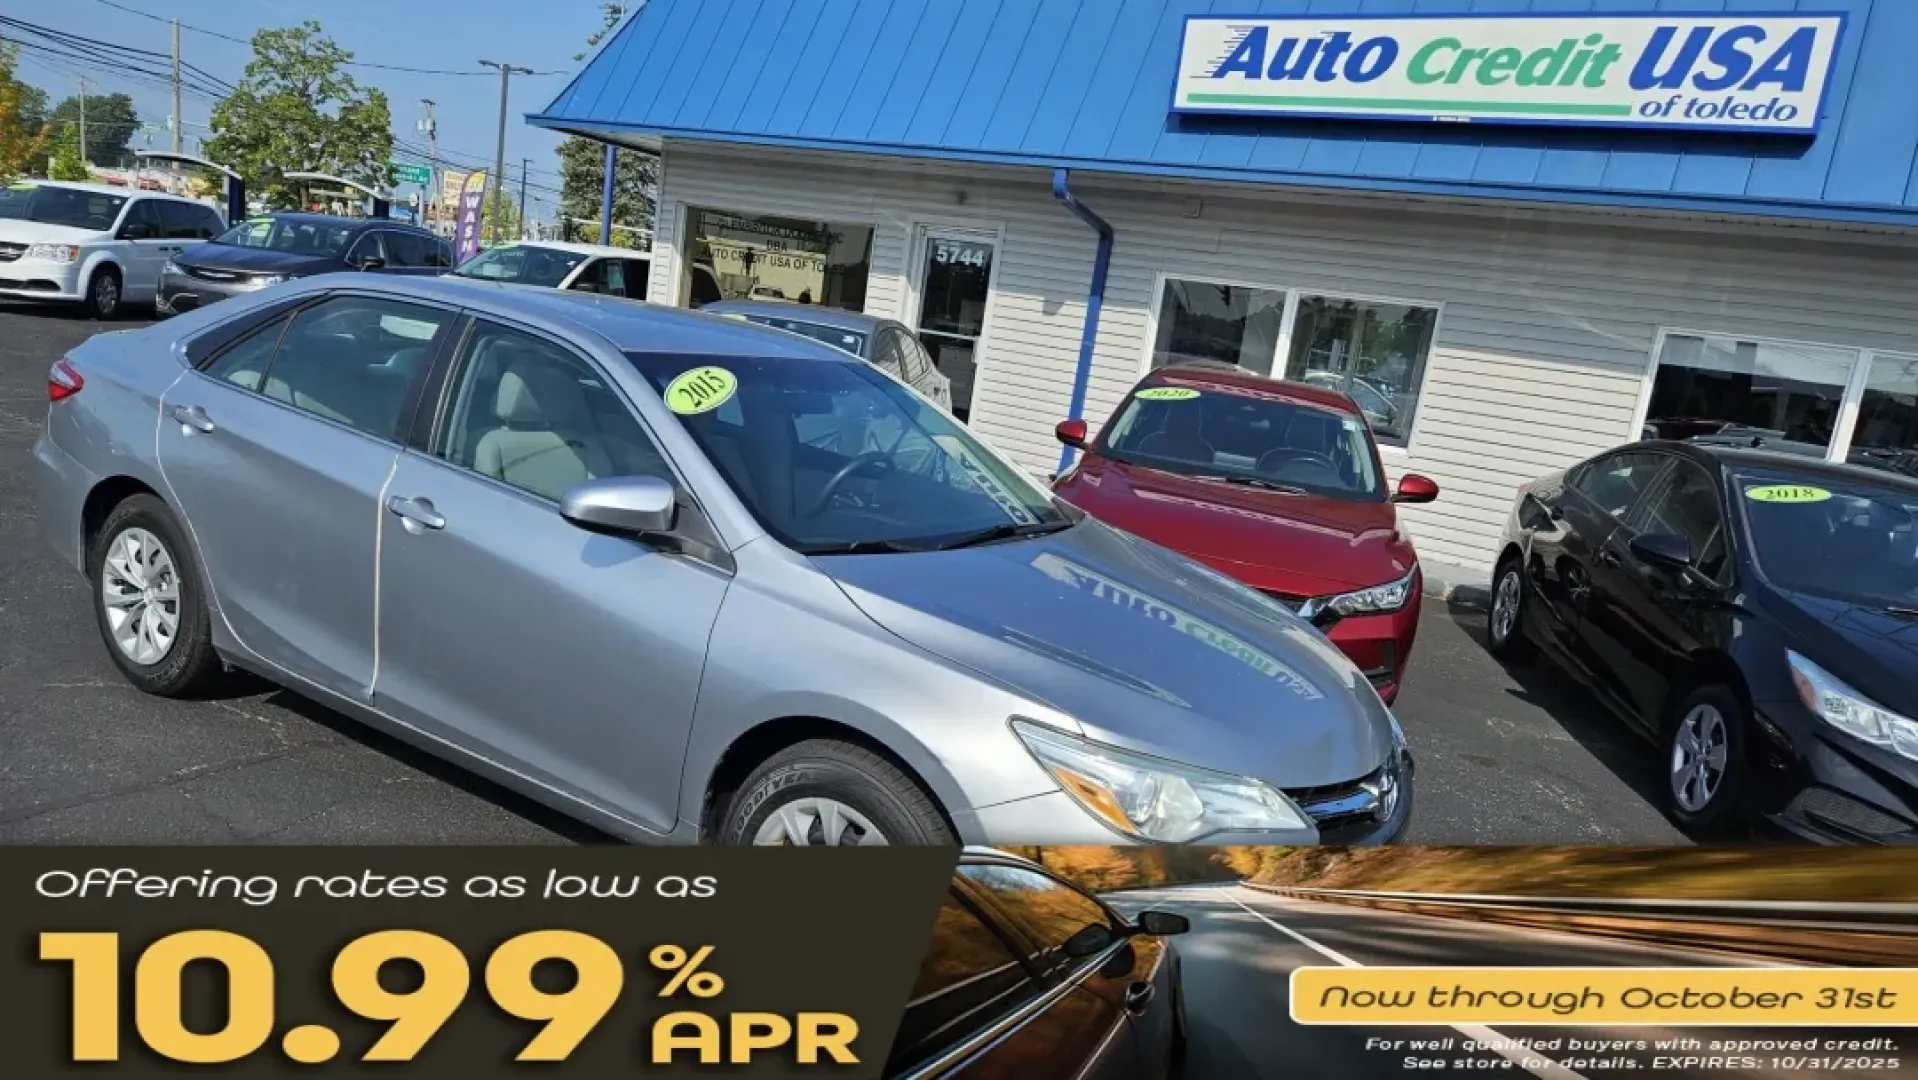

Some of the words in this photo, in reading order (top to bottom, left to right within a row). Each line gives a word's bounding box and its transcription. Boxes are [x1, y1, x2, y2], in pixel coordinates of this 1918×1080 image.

[1210, 26, 1399, 82] Auto
[1406, 33, 1622, 88] Credit
[1628, 25, 1818, 92] USA
[1638, 94, 1683, 118] of
[1683, 96, 1798, 121] toledo
[461, 196, 480, 253] WASH
[770, 255, 790, 268] USA
[936, 246, 983, 267] 5744
[678, 369, 725, 408] 2015
[1765, 488, 1814, 499] 2018
